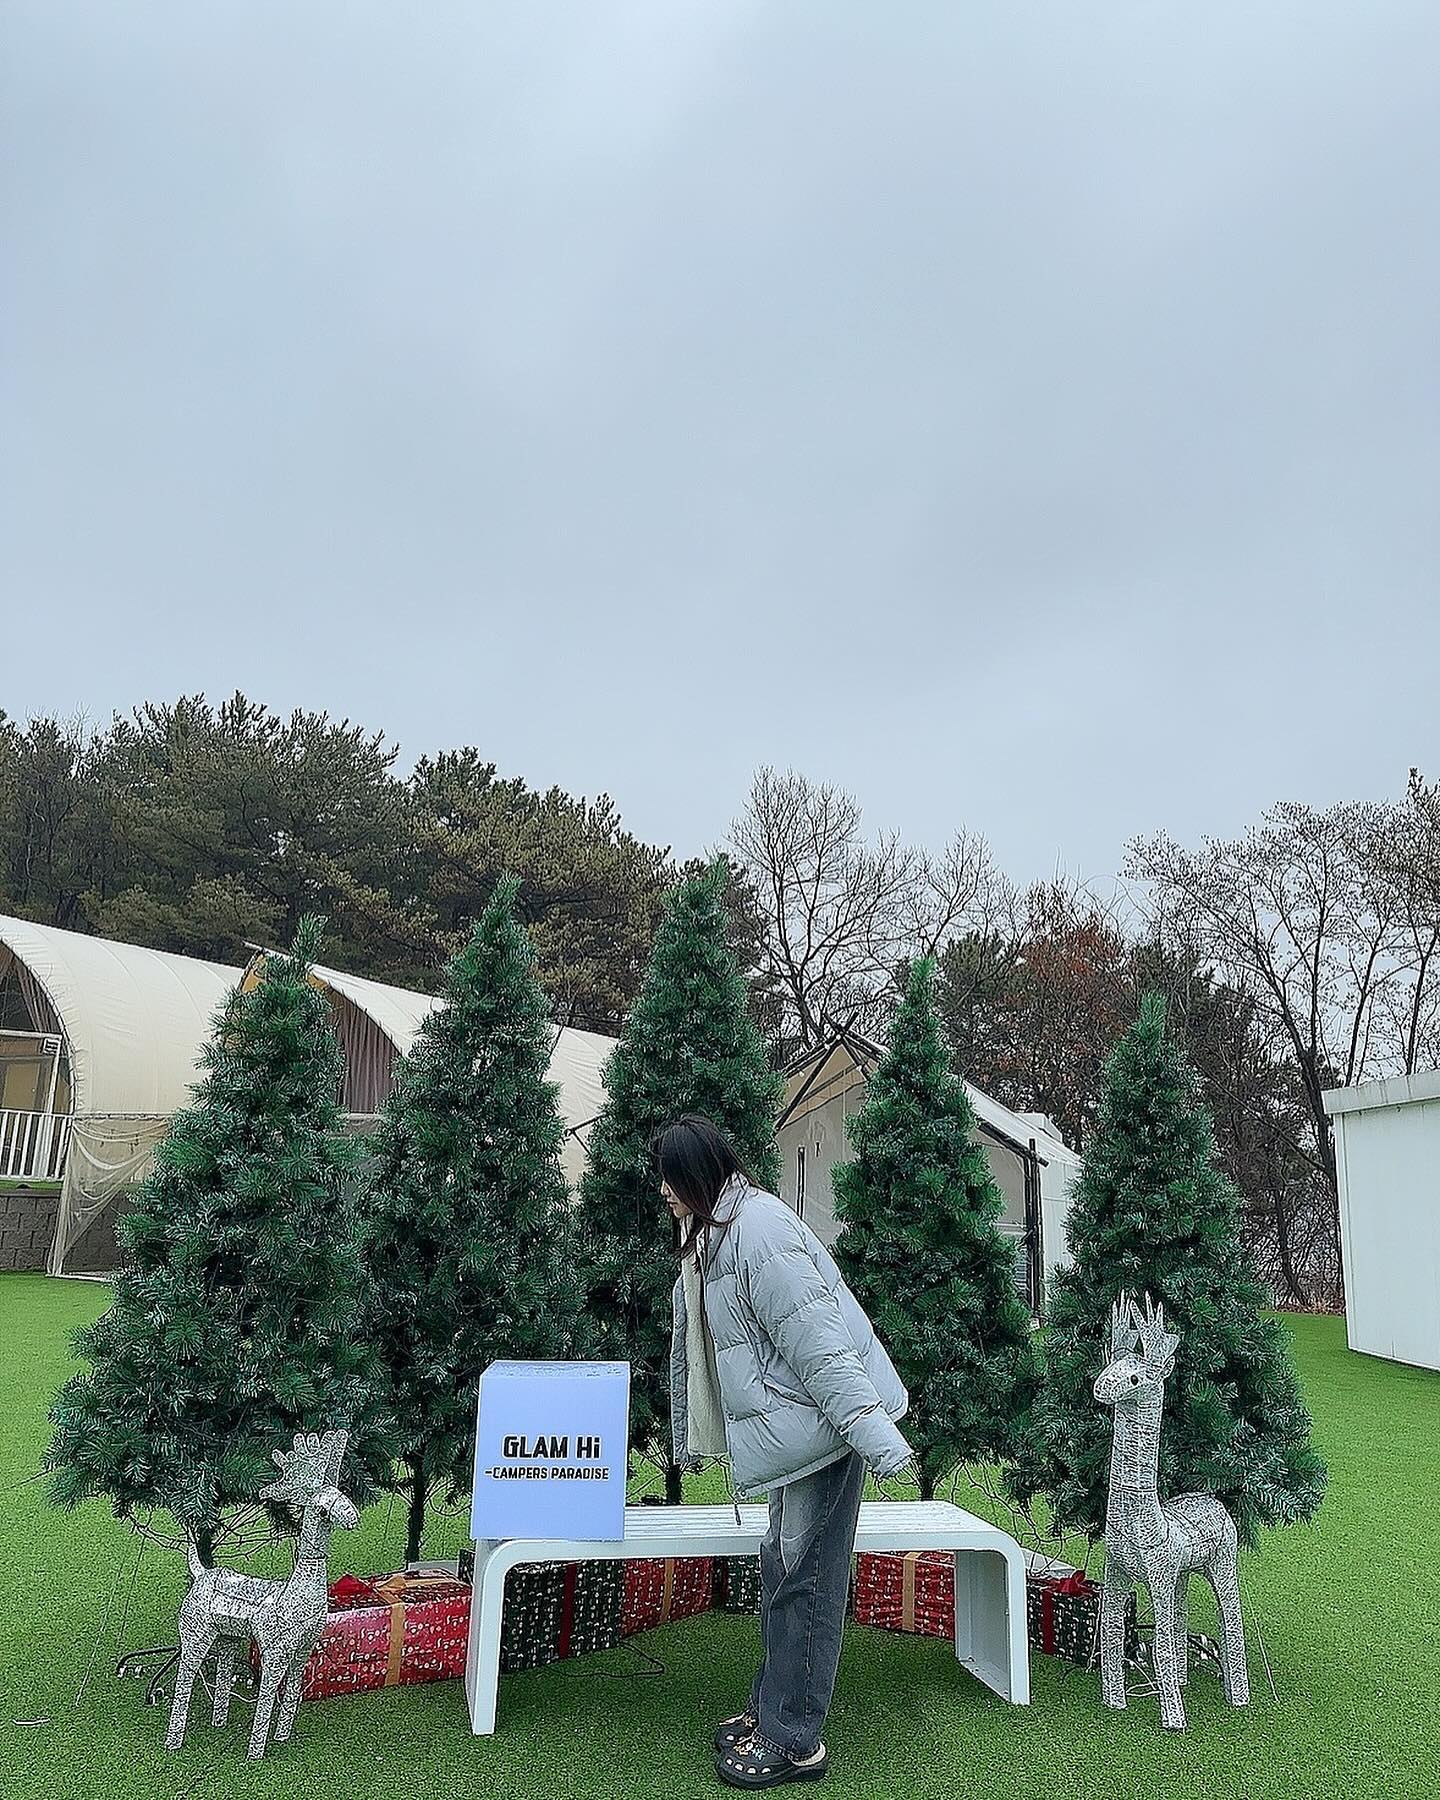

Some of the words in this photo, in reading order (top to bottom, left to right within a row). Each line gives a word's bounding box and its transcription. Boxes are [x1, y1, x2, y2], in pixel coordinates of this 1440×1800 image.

[503, 1436, 568, 1458] GLAM
[576, 1436, 600, 1458] Hi
[551, 1467, 609, 1480] PARADISE
